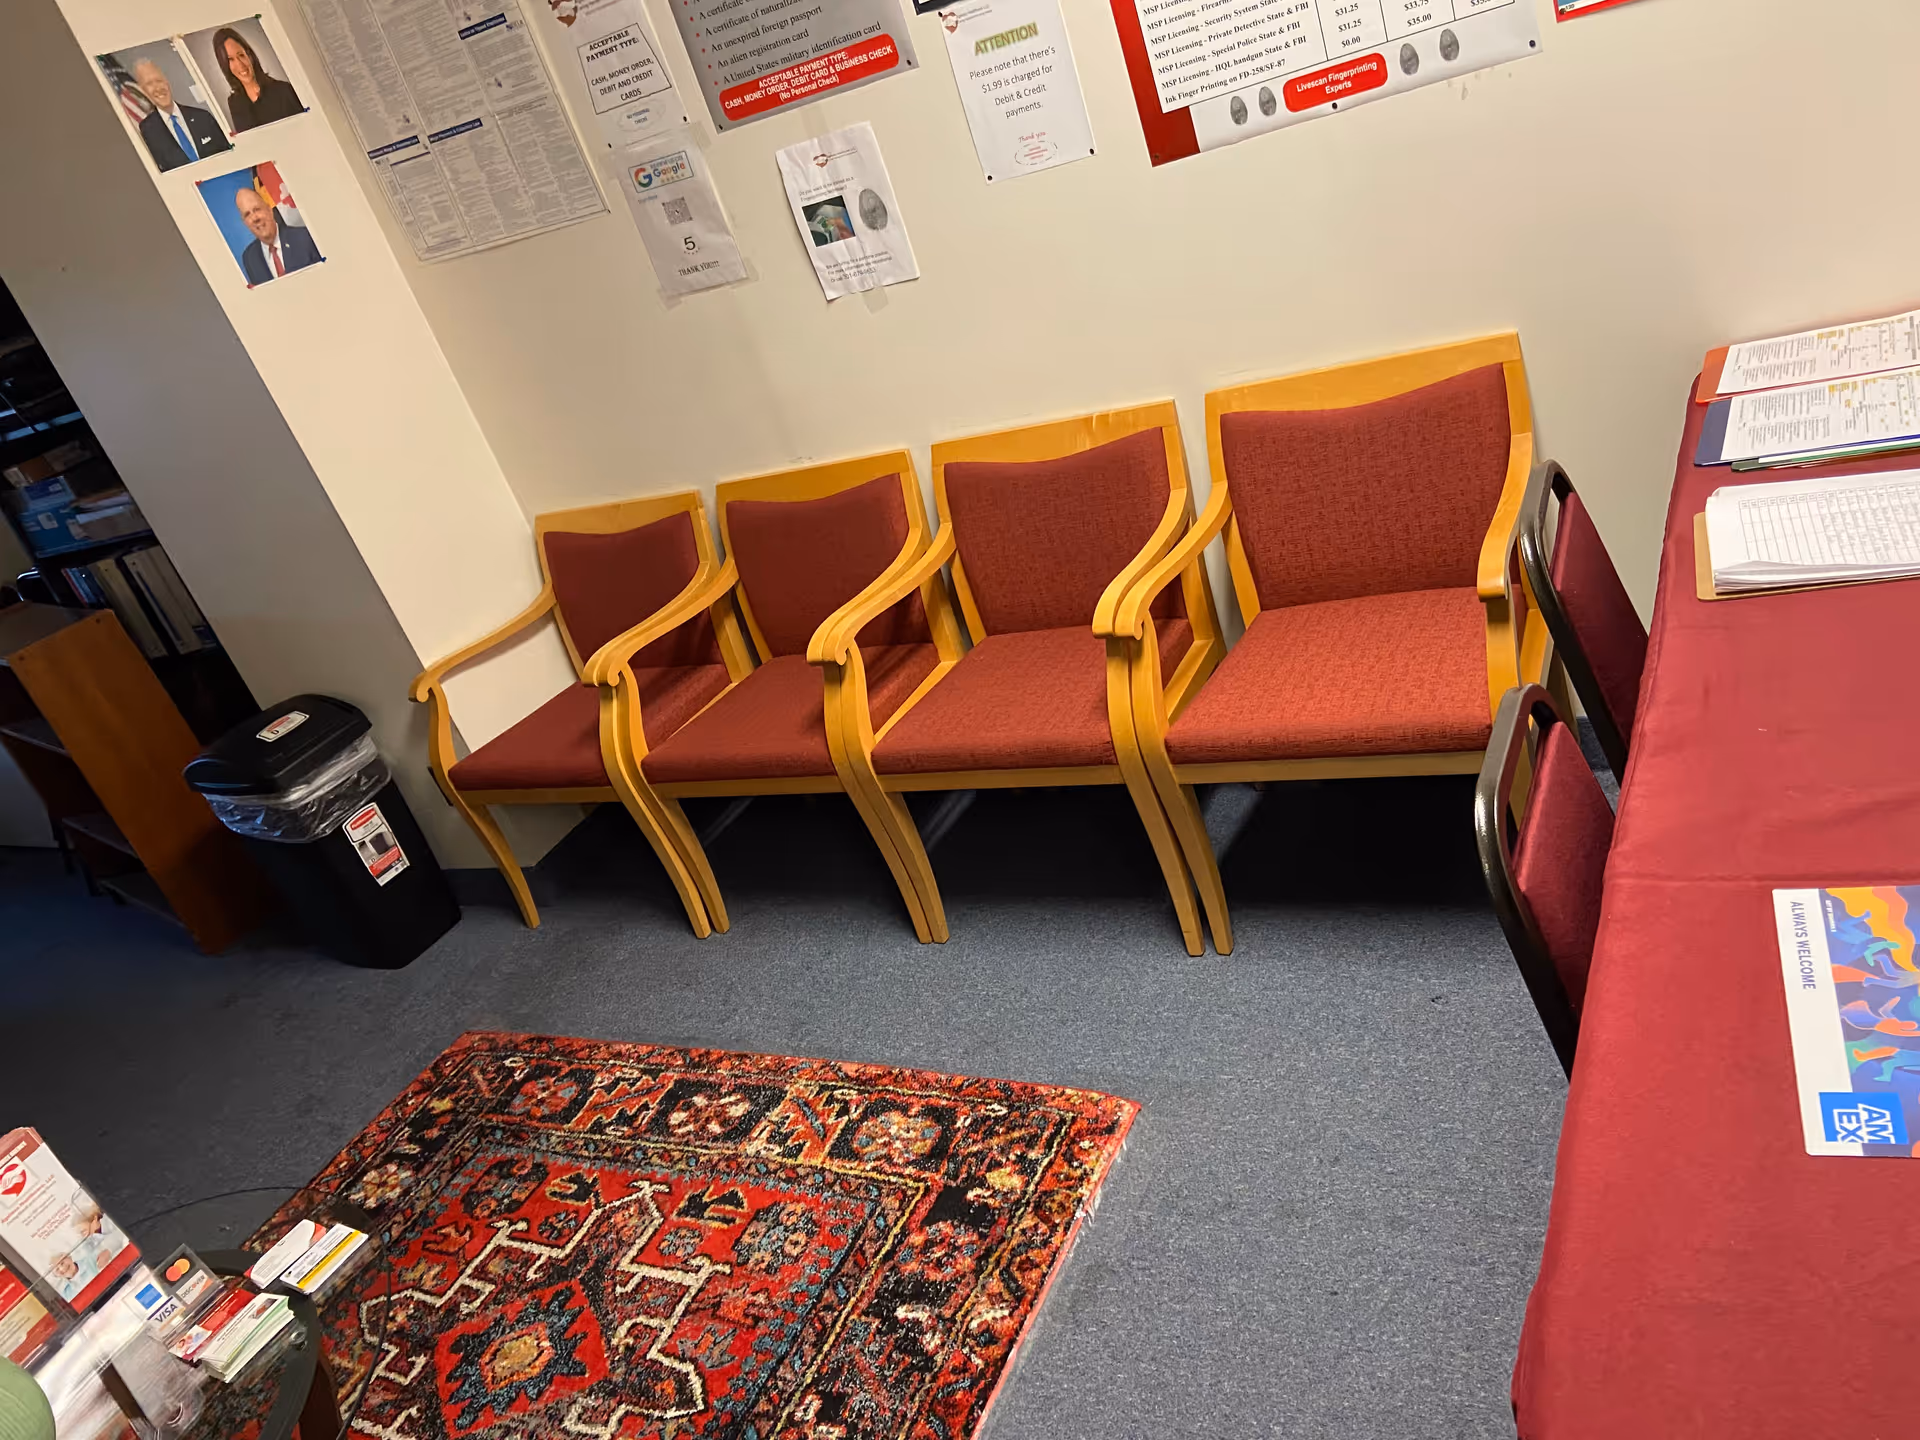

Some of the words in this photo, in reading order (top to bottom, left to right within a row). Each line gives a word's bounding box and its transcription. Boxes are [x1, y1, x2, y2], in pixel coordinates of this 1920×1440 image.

[699, 12, 706, 20] A
[707, 0, 744, 17] certificate
[705, 27, 713, 37] A
[713, 15, 750, 34] certificate
[750, 8, 759, 20] of
[760, 0, 803, 16] naturaliza
[1143, 5, 1159, 16] MSP
[1160, 0, 1193, 10] Licen
[1147, 20, 1163, 31] MSP
[1164, 9, 1196, 25] Licensing
[1335, 3, 1359, 16] $31.25
[1407, 13, 1432, 27] $35.00
[711, 43, 723, 53] An
[723, 27, 760, 48] unexpired
[761, 19, 789, 35] foreign
[790, 6, 822, 26] passport
[1150, 34, 1167, 46] MSP
[1167, 24, 1200, 40] Licensing
[1204, 13, 1232, 27] Security
[1233, 3, 1259, 18] System
[1154, 49, 1170, 61] MSP
[1171, 39, 1203, 55] Licensing
[1208, 29, 1233, 42] Private
[1233, 18, 1266, 34] Detective
[1266, 11, 1285, 22] State
[1286, 7, 1293, 15] &
[1294, 1, 1309, 13] FBI
[1338, 19, 1362, 33] $31.25
[586, 45, 618, 62] PAYMENT
[619, 37, 639, 49] TYPE:
[589, 30, 629, 51] ACCEPTABLE
[717, 60, 729, 69] An
[730, 52, 748, 65] alien
[749, 37, 792, 57] registration
[791, 28, 810, 42] card
[723, 75, 730, 85] A
[730, 64, 756, 82] United
[756, 60, 779, 72] States
[780, 47, 809, 65] military
[811, 30, 862, 53] identification
[863, 20, 882, 34] card
[974, 22, 1038, 56] ATTENTION
[1158, 65, 1174, 75] MSP
[1175, 54, 1207, 70] Licensing
[1211, 44, 1236, 58] Special
[1236, 36, 1257, 48] Police
[1258, 30, 1277, 41] State
[1286, 21, 1301, 32] FBI
[1341, 36, 1361, 48] $0.00
[591, 75, 608, 86] CASH,
[608, 66, 630, 79] MONEY
[630, 58, 654, 71] ORDER,
[724, 96, 745, 109] CASH,
[744, 90, 766, 103] MONEY
[766, 82, 791, 95] ORDER,
[790, 74, 809, 87] DEBIT
[810, 68, 829, 80] CARD
[829, 66, 835, 74] &
[835, 54, 868, 72] BUSINESS
[868, 44, 893, 60] CHECK
[758, 68, 800, 88] ACCEPTABLE
[799, 57, 829, 74] PAYMENT
[829, 51, 849, 64] TYPE:
[969, 67, 993, 80] Please
[994, 61, 1011, 74] note
[1012, 55, 1028, 67] that
[1028, 46, 1056, 62] there's
[1161, 78, 1178, 90] MSP
[1178, 69, 1210, 84] Licensing
[1215, 61, 1233, 72] HQL
[1233, 51, 1264, 66] handgun
[1264, 45, 1283, 56] State
[1284, 41, 1291, 49] &
[1292, 35, 1307, 46] FBI
[600, 84, 617, 96] DEBIT
[618, 78, 632, 88] AND
[632, 70, 653, 83] CREDIT
[779, 91, 791, 102] (No
[791, 81, 818, 96] Personal
[818, 74, 839, 88] Check)
[982, 80, 1002, 95] $1.99
[1003, 77, 1010, 87] is
[1011, 68, 1040, 86] charged
[1042, 64, 1053, 77] for
[1165, 95, 1176, 104] Ink
[1178, 88, 1199, 100] Finger
[1200, 79, 1228, 92] Printing
[1239, 59, 1286, 80] FD-258/SF-87
[1296, 77, 1327, 92] Livescan
[1328, 62, 1377, 82] Fingerprinting
[1325, 81, 1352, 94] Experts
[620, 88, 642, 101] CARDS
[994, 90, 1014, 106] Debit
[1016, 90, 1023, 99] &
[1024, 84, 1047, 97] Credit
[1005, 100, 1044, 119] payments.
[1018, 132, 1034, 143] Thank
[653, 162, 686, 177] Google
[684, 236, 696, 251] 5
[678, 265, 700, 276] THANK
[1790, 901, 1808, 938] ALWAYS
[1796, 940, 1816, 990] WELCOME
[1833, 1109, 1863, 1143] EX
[1858, 1103, 1895, 1144] AM
[180, 1275, 205, 1298] DISCOVER
[154, 1303, 178, 1323] VISA
